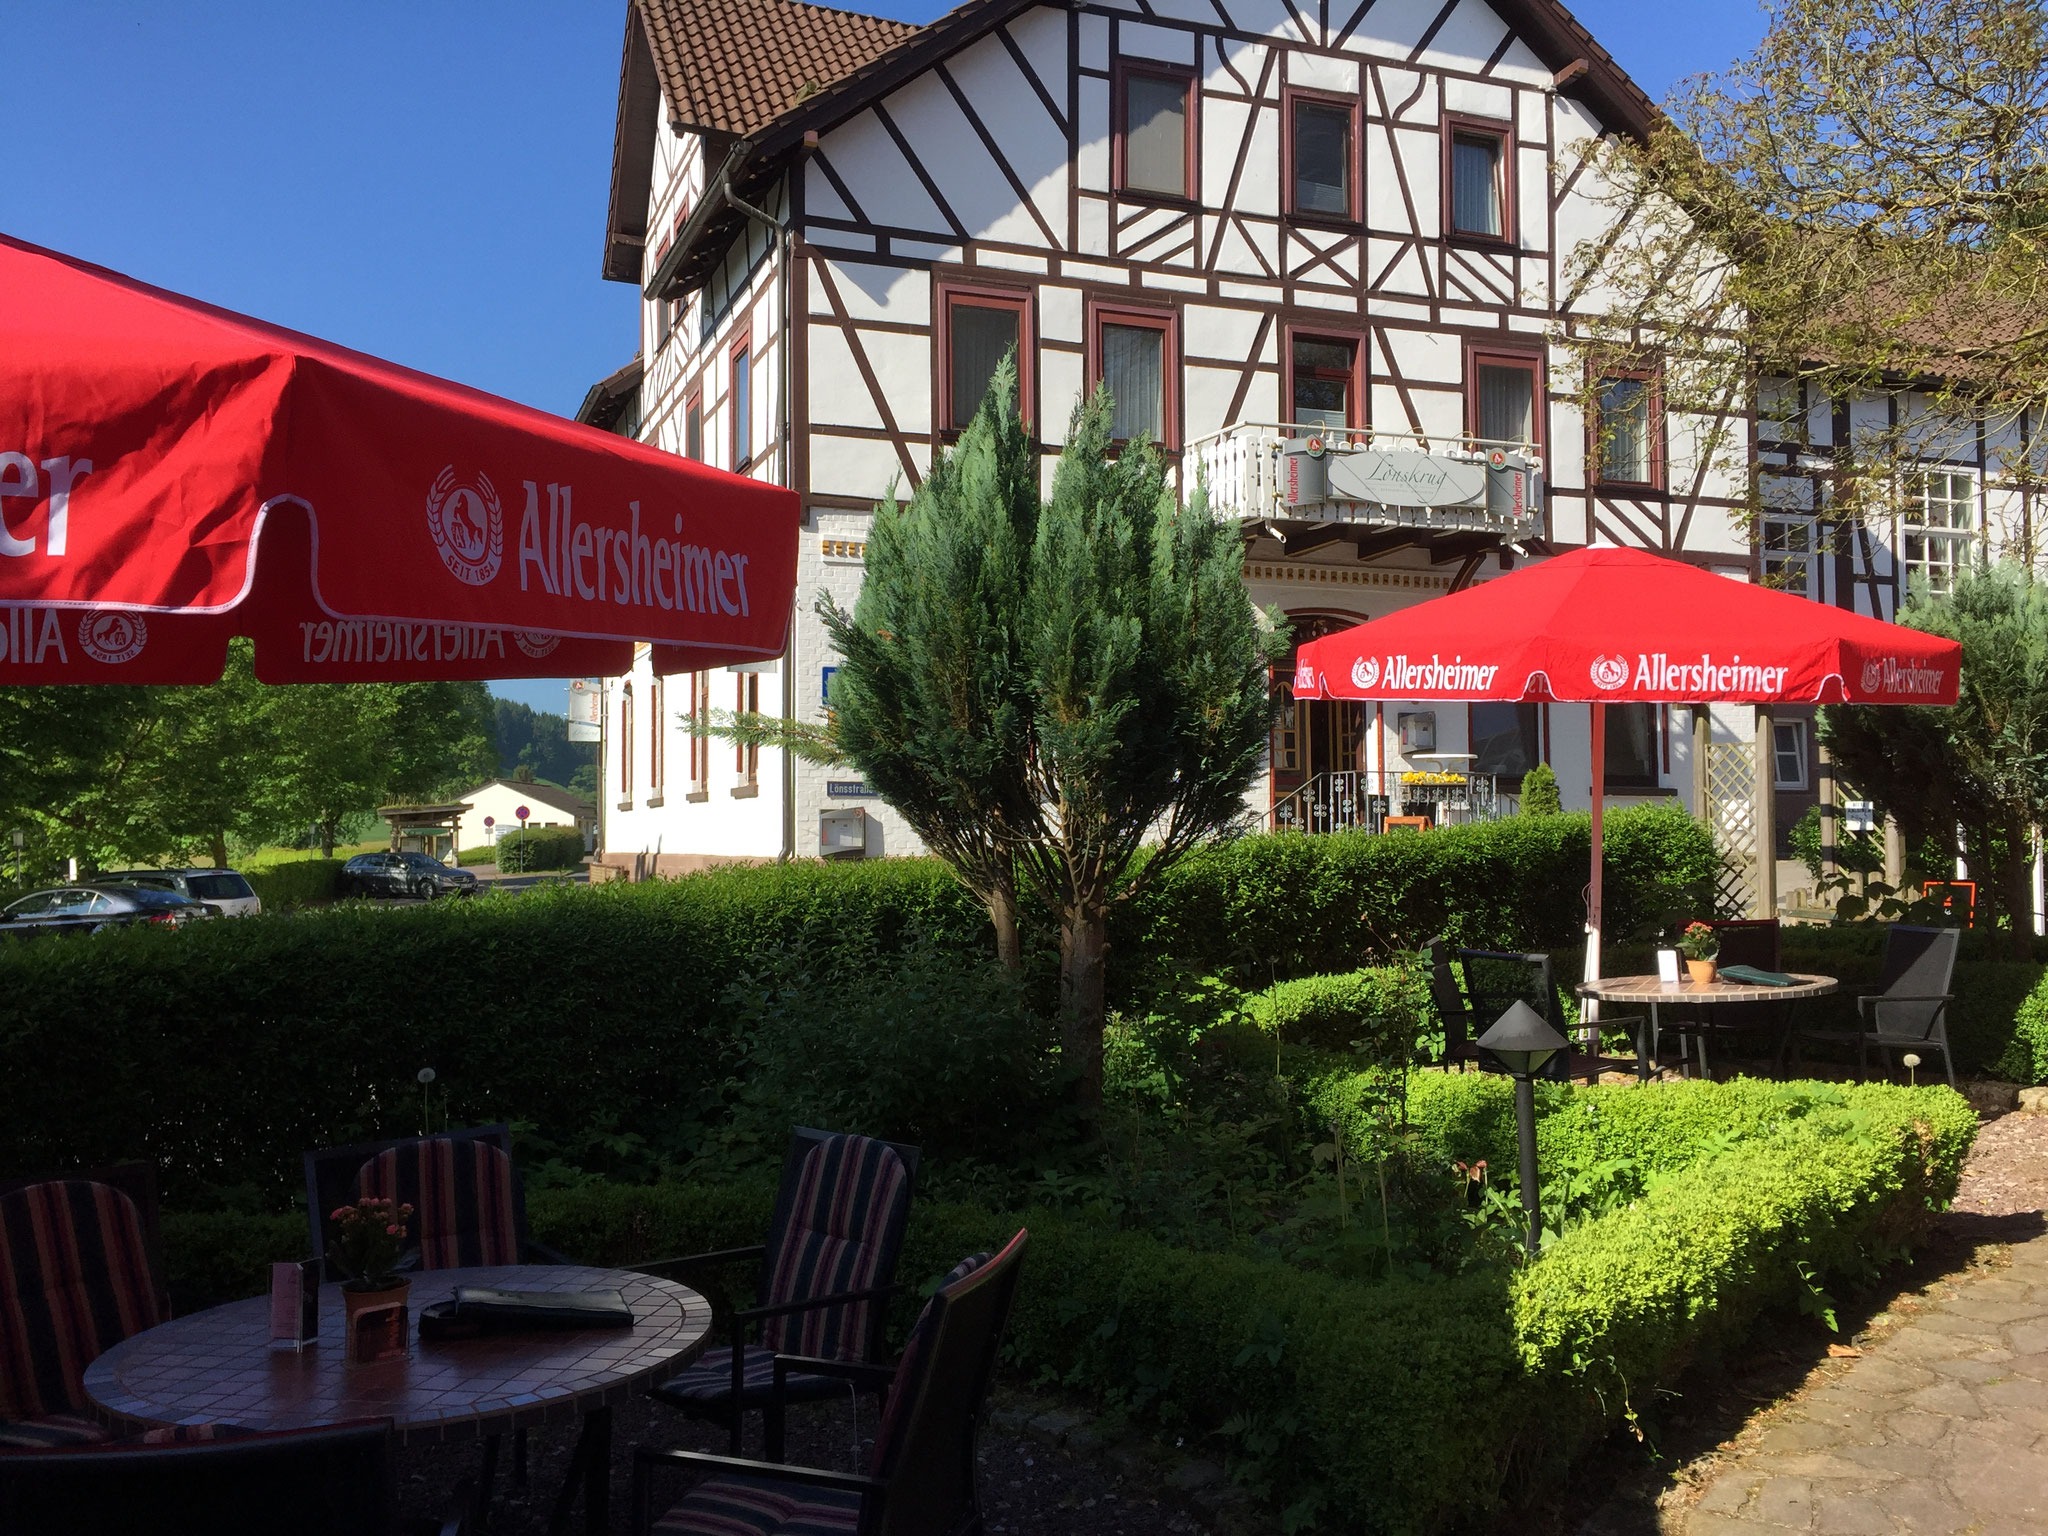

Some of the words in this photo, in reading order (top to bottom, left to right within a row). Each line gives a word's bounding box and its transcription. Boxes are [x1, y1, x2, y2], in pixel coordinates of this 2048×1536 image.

[1287, 457, 1299, 504] Allersheimer
[1512, 472, 1523, 517] Allersheimer
[446, 555, 471, 580] SEIT
[475, 561, 495, 582] 1854
[519, 479, 749, 617] Allersheimer
[1381, 654, 1499, 691] Allersheimer
[1633, 653, 1789, 694] Allersheimer
[1883, 658, 1945, 695] Allersheimer
